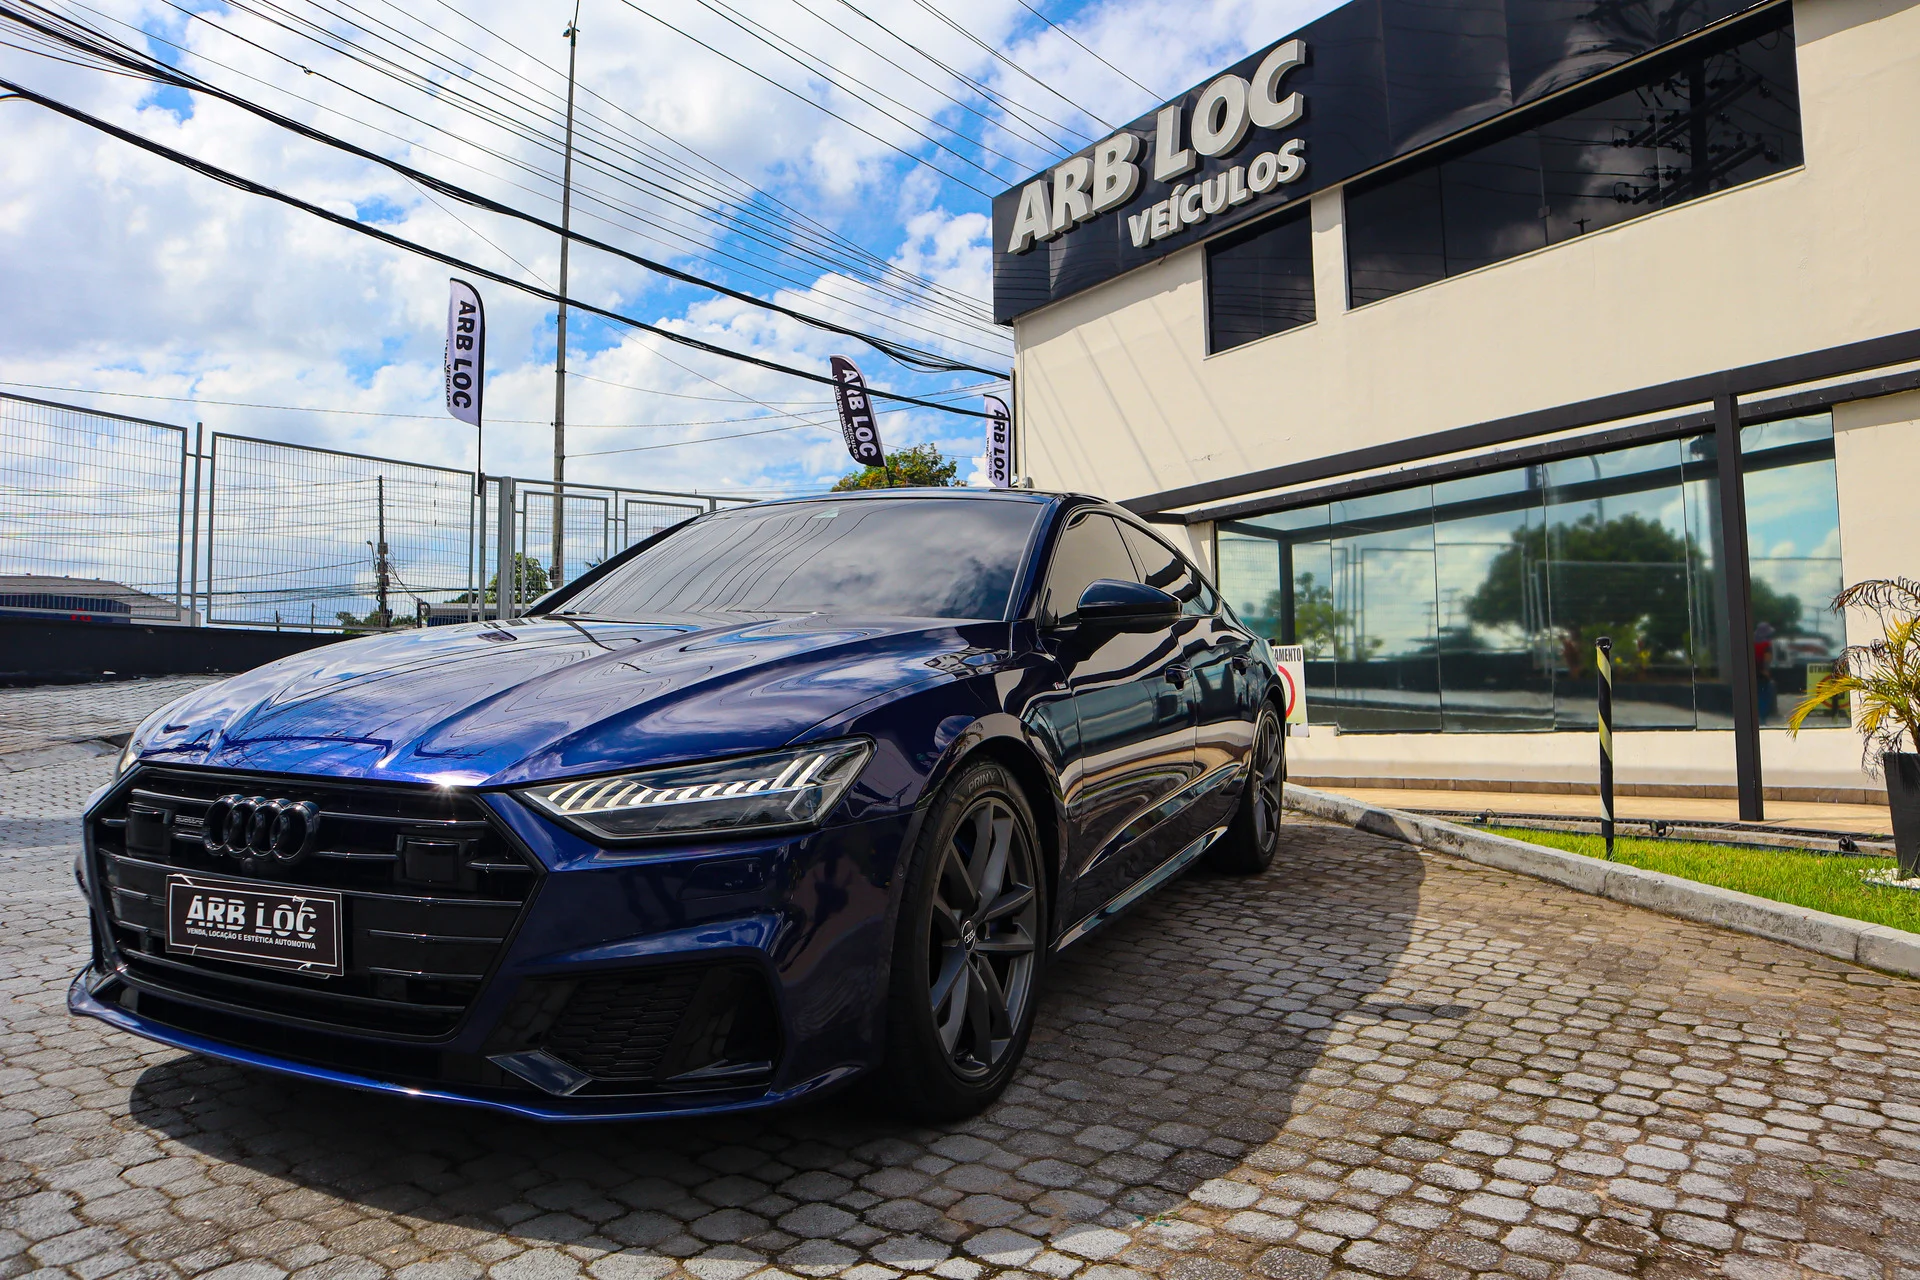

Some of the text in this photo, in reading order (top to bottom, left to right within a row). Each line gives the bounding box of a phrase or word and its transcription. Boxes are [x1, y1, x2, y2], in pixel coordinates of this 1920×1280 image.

[1007, 38, 1307, 254] ARB LOC
[1127, 138, 1307, 248] VEÍCULOS
[452, 300, 475, 408] ARB LOC
[833, 375, 841, 400] LOAÇÃO
[843, 370, 877, 457] ARB LOC
[848, 423, 859, 459] VEÍCULOS
[994, 410, 1005, 481] ARB LOC
[1272, 648, 1302, 662] AMENTO
[185, 894, 317, 940] ARB LOC
[186, 927, 208, 937] VENDA,
[208, 928, 237, 940] LOCAÇÃO
[243, 933, 274, 944] ESTÉTICA
[274, 938, 317, 950] AUTOMOTIVA
